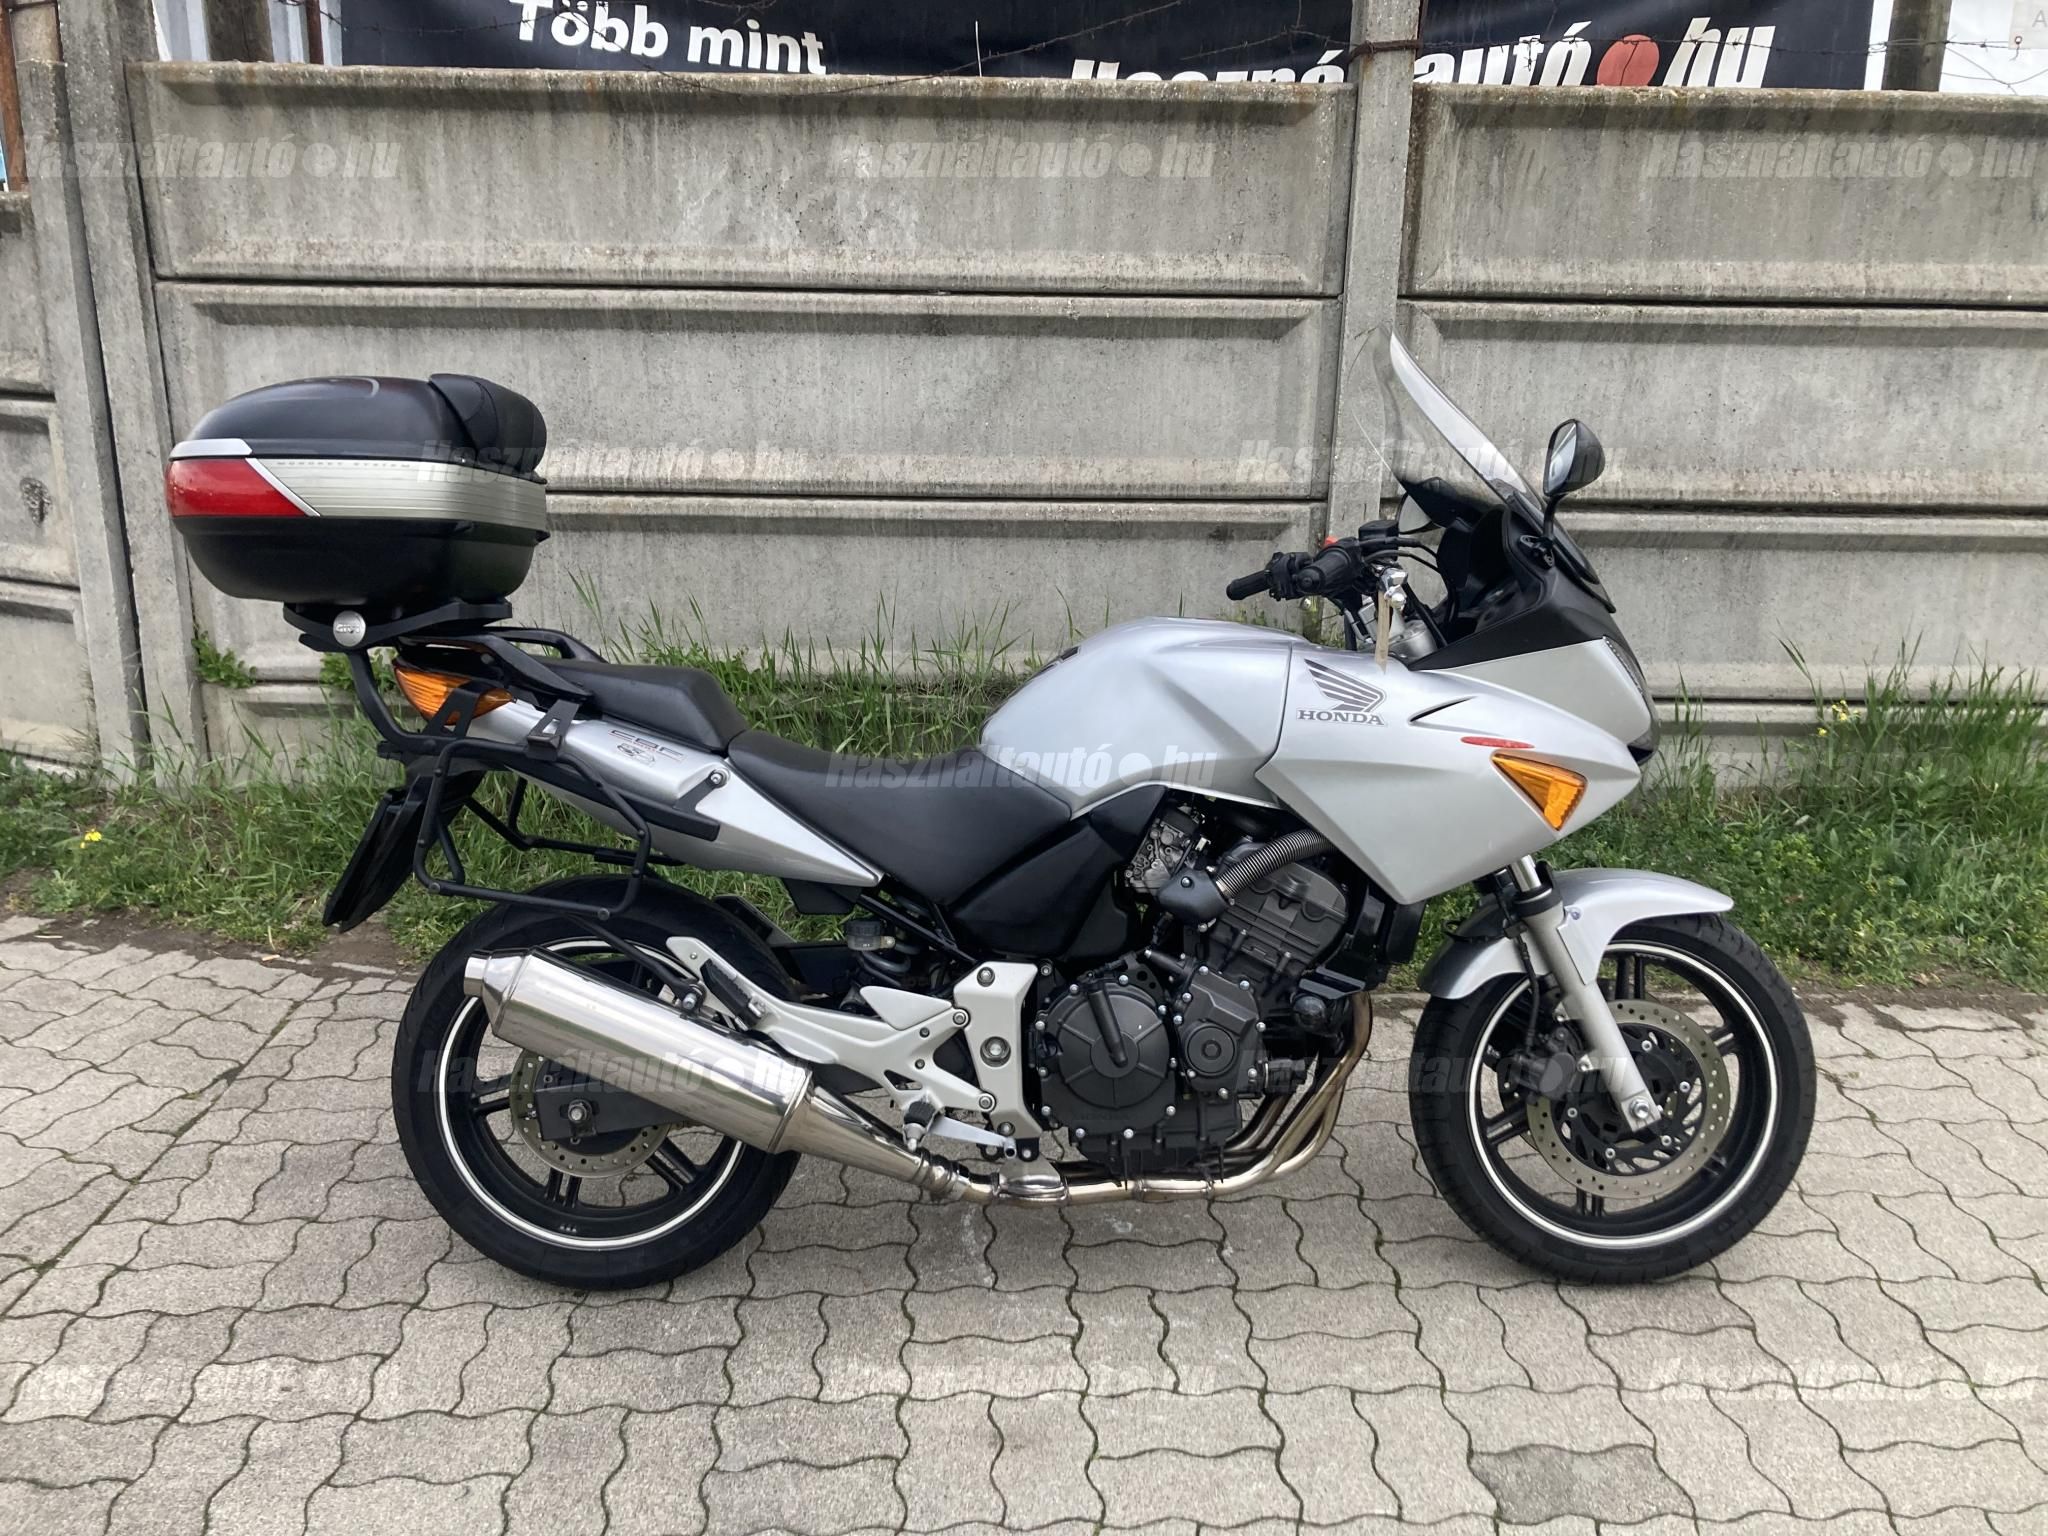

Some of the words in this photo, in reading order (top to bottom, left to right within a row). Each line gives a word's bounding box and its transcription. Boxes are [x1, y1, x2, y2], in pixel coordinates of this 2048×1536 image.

[509, 0, 669, 57] Több
[686, 19, 827, 75] mint
[1298, 710, 1385, 726] HONDA
